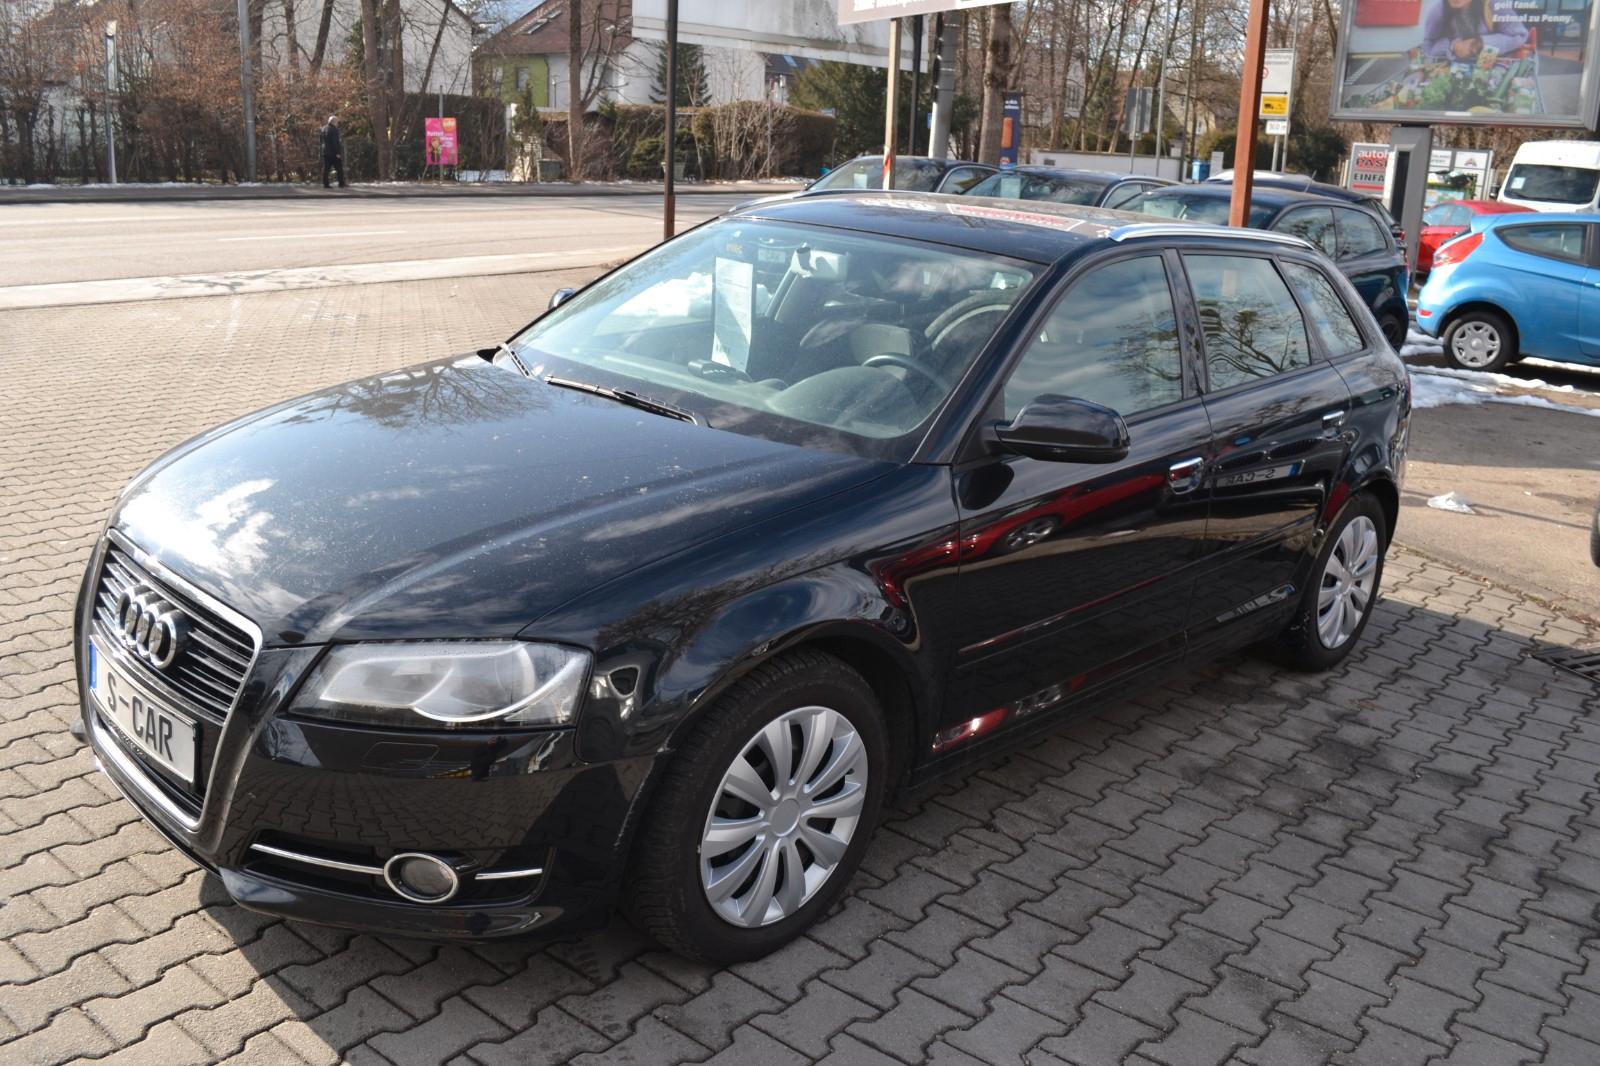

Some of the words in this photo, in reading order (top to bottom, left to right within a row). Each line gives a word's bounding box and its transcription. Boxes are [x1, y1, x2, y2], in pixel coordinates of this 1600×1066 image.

[1492, 14, 1527, 22] Erstmal
[1541, 14, 1574, 24] Penny.
[107, 671, 174, 762] S-CAR
